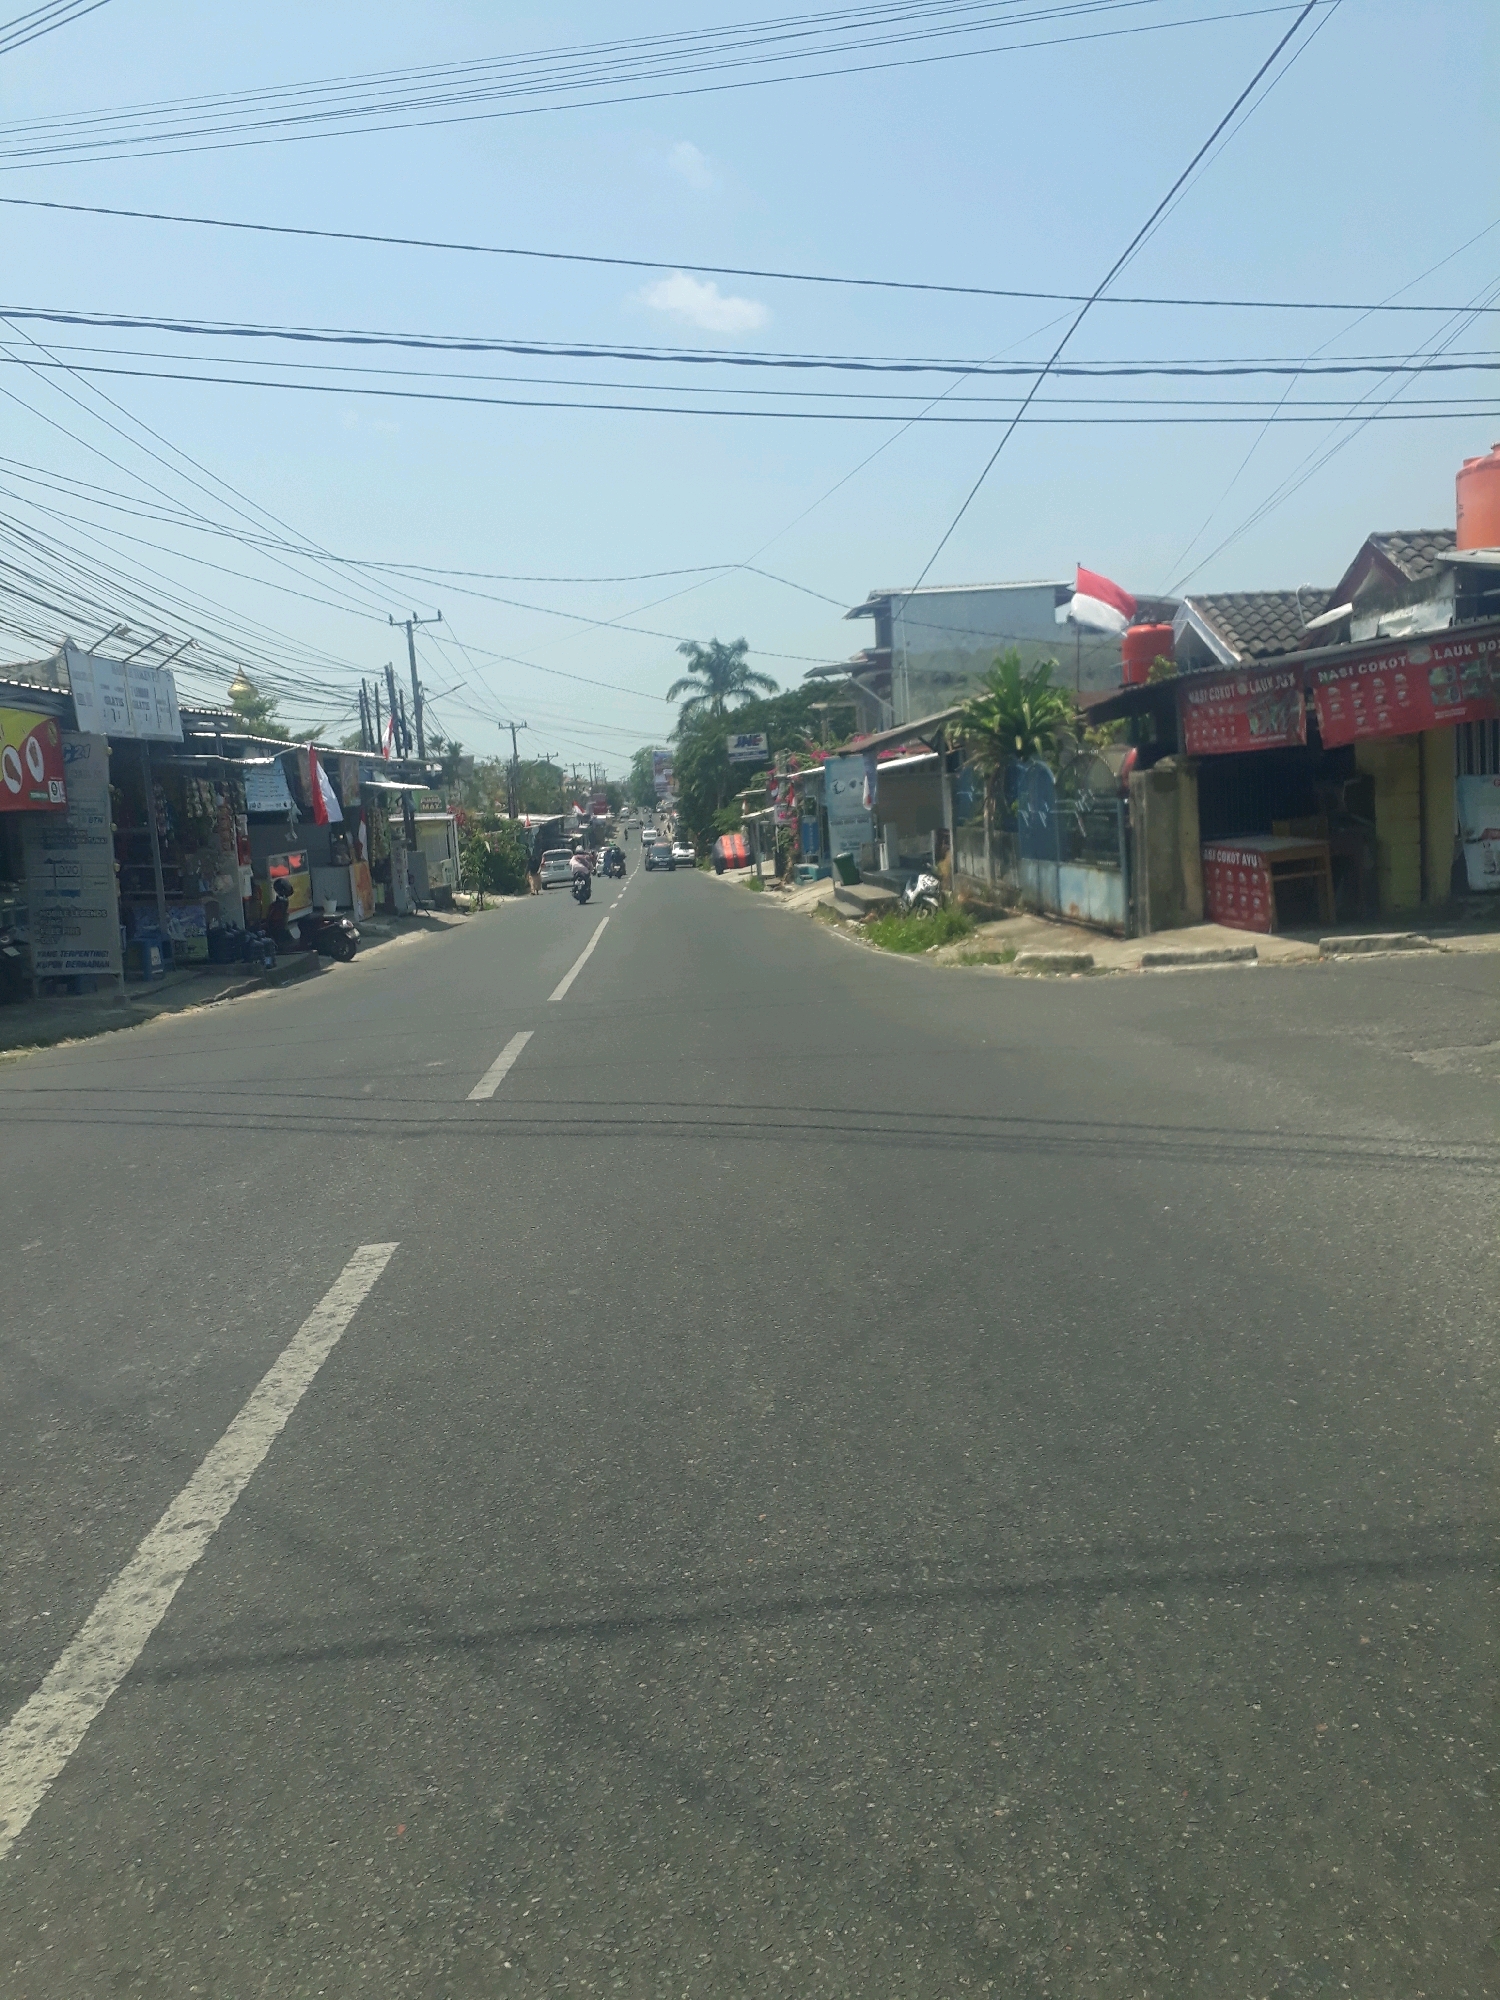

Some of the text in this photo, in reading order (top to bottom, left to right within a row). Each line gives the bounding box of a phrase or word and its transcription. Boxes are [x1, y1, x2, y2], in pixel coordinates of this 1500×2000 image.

[1318, 669, 1354, 683] NASI
[1358, 655, 1407, 674] COKOT
[1433, 644, 1473, 660] LAUK
[1209, 683, 1235, 701] COKOT
[1249, 676, 1273, 694] LAUK
[1217, 850, 1240, 865] COKOT
[1242, 853, 1258, 868] AYU
